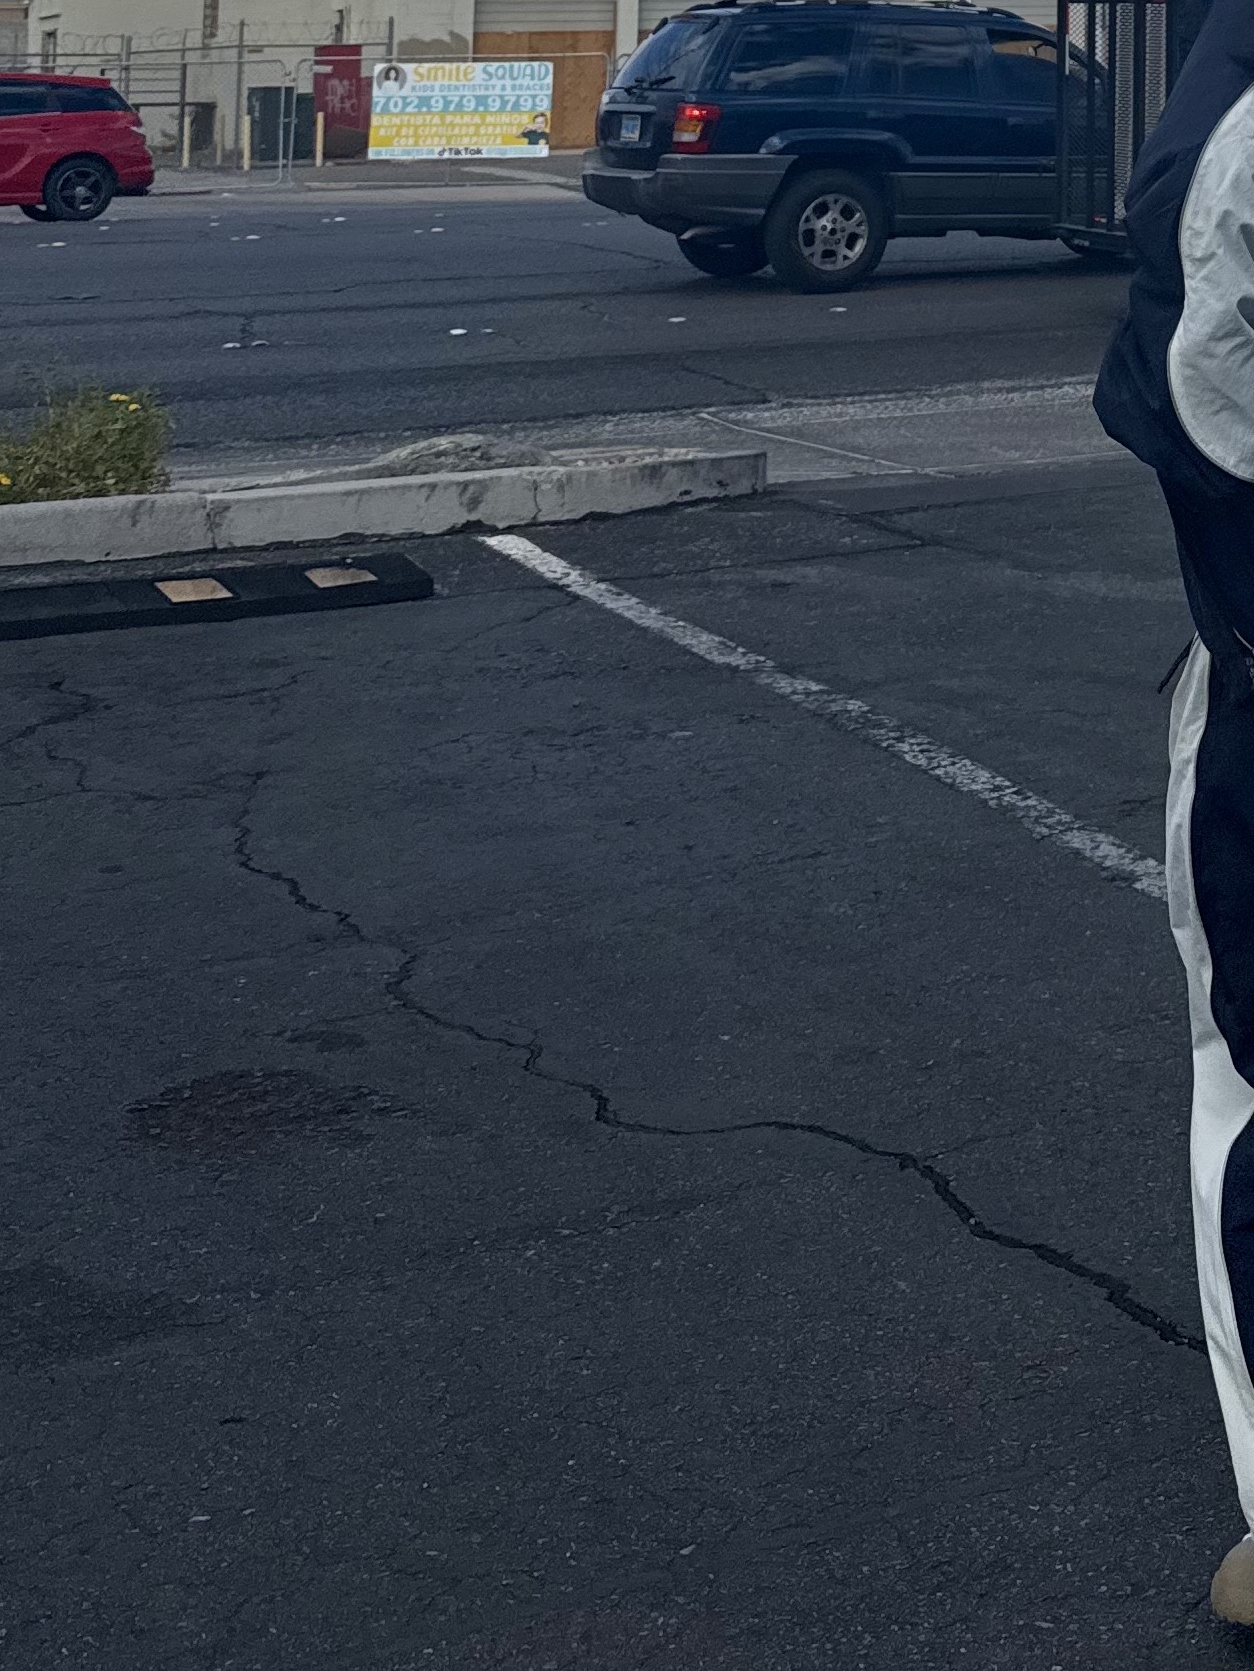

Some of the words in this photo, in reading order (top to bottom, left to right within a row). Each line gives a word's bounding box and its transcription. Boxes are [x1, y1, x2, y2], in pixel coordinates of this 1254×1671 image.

[482, 63, 550, 82] SQUAD
[411, 84, 436, 93] KIDS
[438, 84, 498, 93] DENTISTRY
[511, 83, 551, 92] BRACES
[374, 95, 549, 113] 702.979.9799
[372, 115, 442, 125] DENTISTA
[445, 114, 481, 125] PARA
[485, 113, 529, 124] NIÑOS
